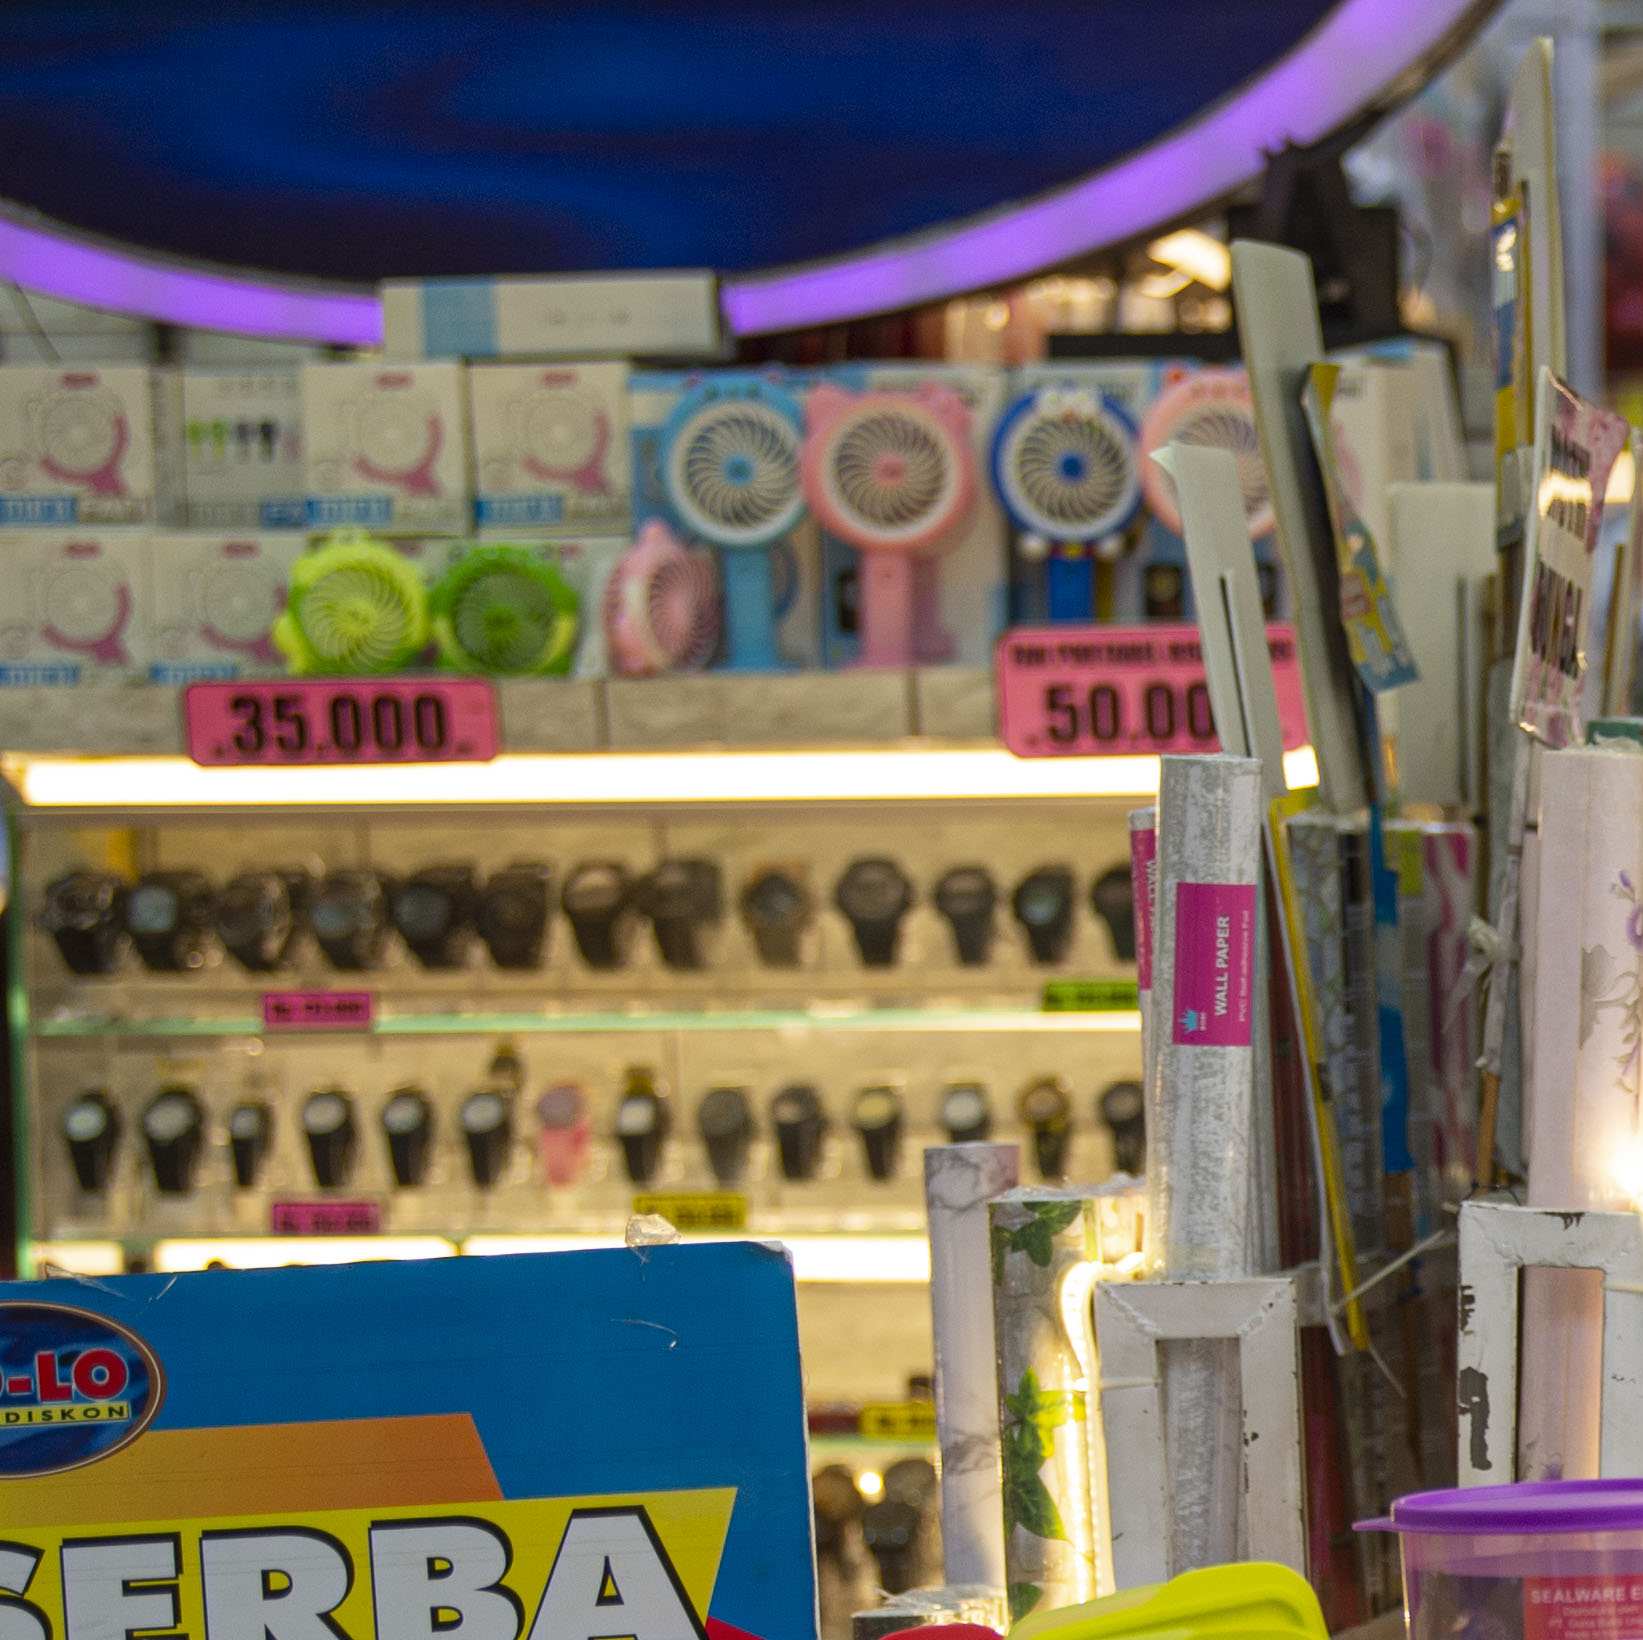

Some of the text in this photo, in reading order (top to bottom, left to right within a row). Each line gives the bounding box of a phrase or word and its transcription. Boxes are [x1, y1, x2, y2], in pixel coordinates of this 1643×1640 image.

[230, 694, 446, 752] 35.000
[1045, 682, 1219, 743] 50.00
[1214, 915, 1231, 1016] WALL PAPER
[0, 1348, 130, 1404] -LO
[5, 1406, 125, 1424] DISKON
[1530, 1585, 1625, 1604] SEALWARE
